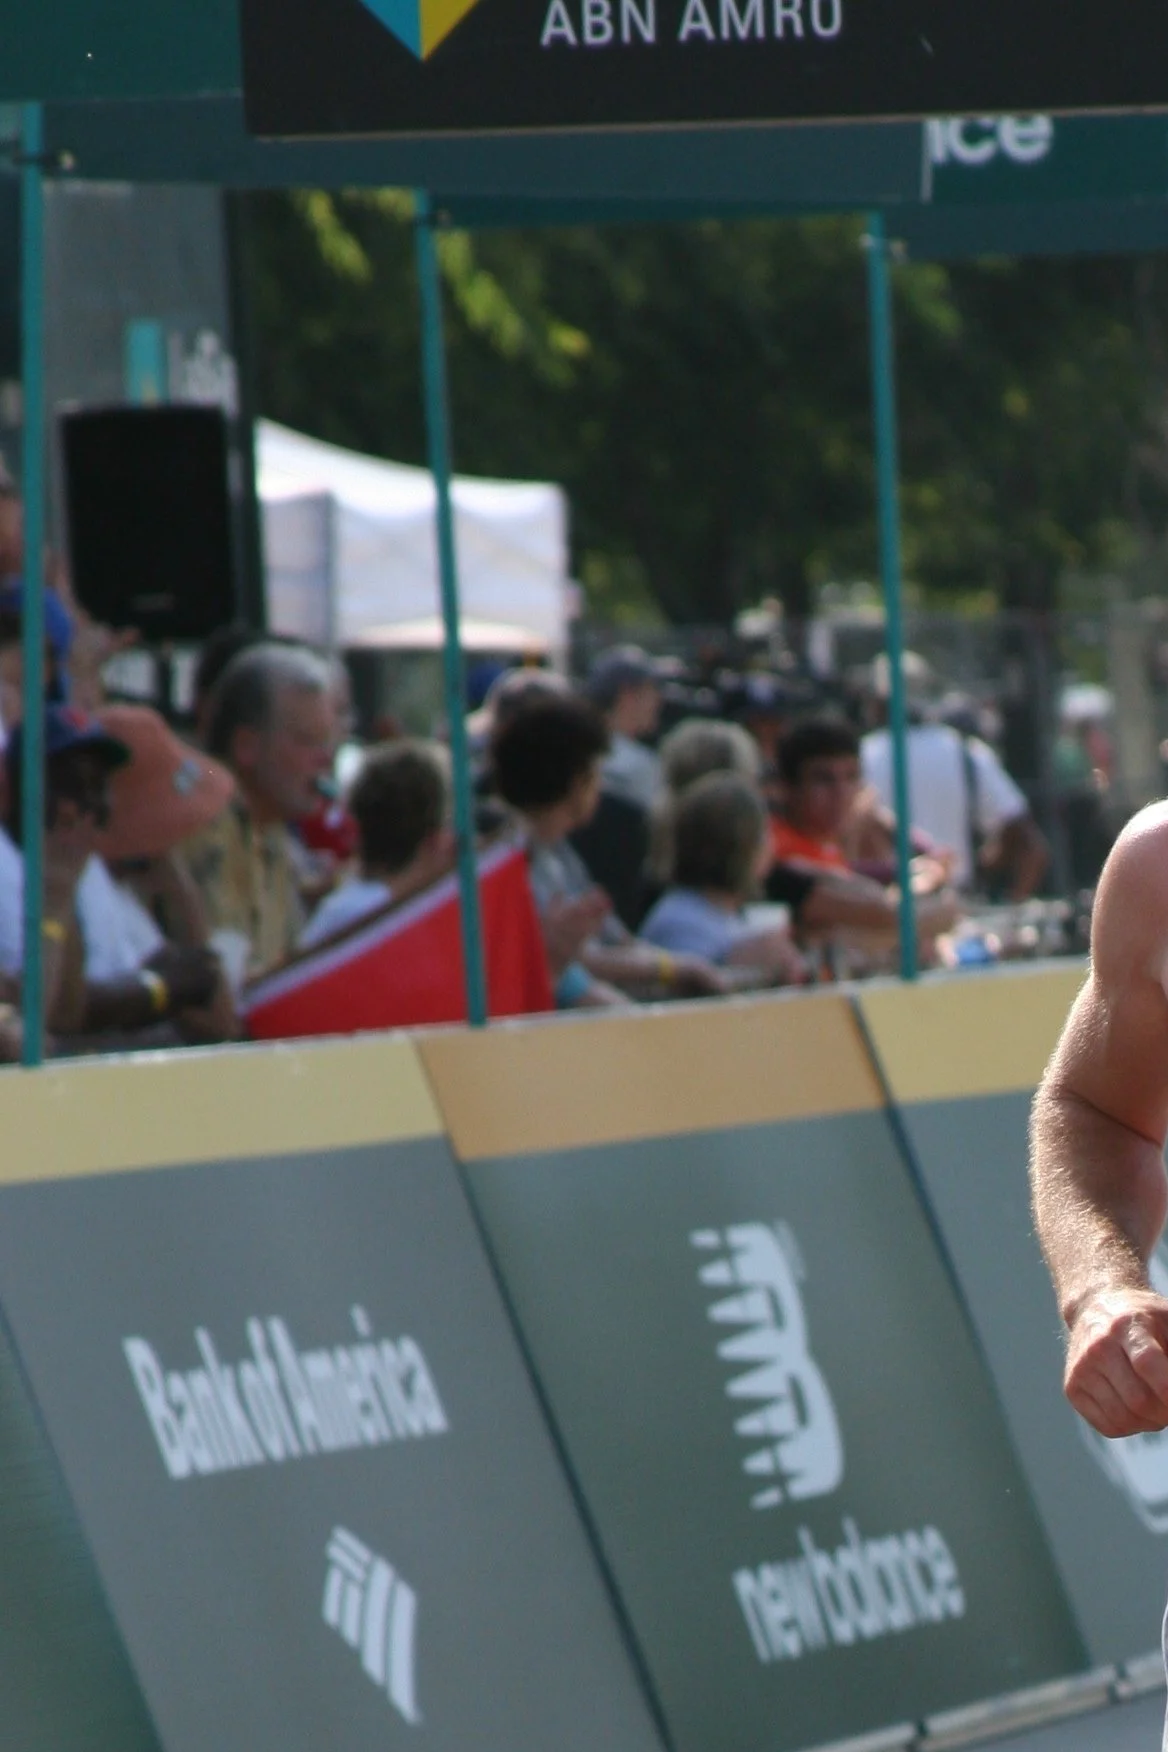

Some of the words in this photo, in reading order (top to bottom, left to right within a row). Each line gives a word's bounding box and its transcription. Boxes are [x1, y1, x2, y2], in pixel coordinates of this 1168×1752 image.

[540, 0, 656, 46] ABN
[677, 0, 843, 42] AMRO
[122, 1326, 266, 1480] Bank
[238, 1315, 304, 1462] of
[268, 1304, 448, 1455] America
